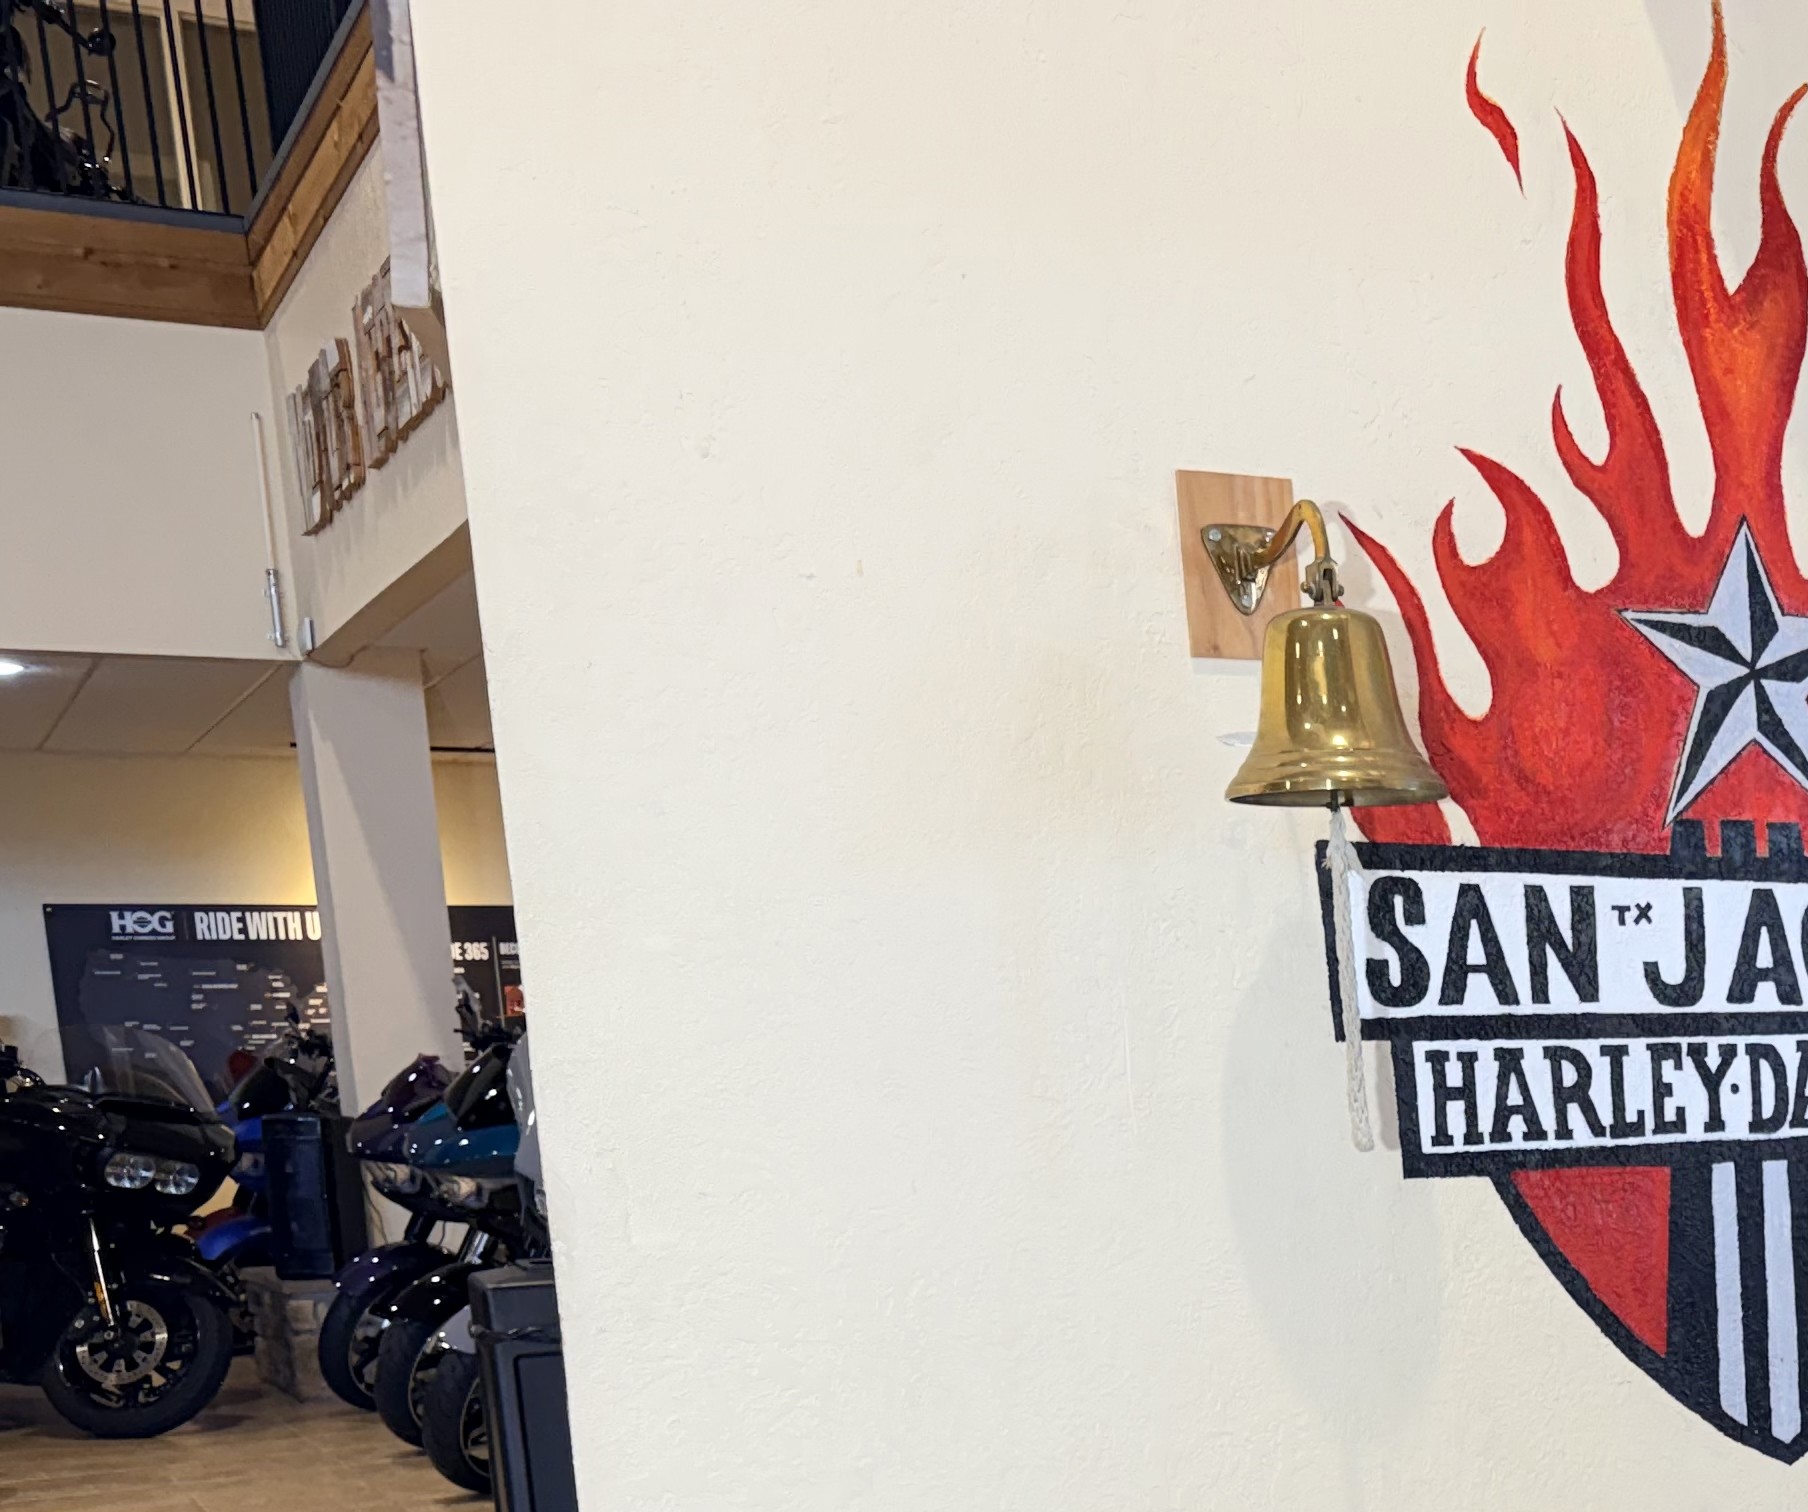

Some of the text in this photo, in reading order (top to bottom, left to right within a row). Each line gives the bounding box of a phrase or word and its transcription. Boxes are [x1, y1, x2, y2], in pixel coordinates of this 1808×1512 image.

[109, 910, 175, 933] HOG
[194, 911, 245, 940] RIDE
[245, 911, 303, 940] WITH
[463, 941, 489, 961] 365
[1366, 874, 1601, 1009] SAN
[1611, 901, 1654, 927] TX
